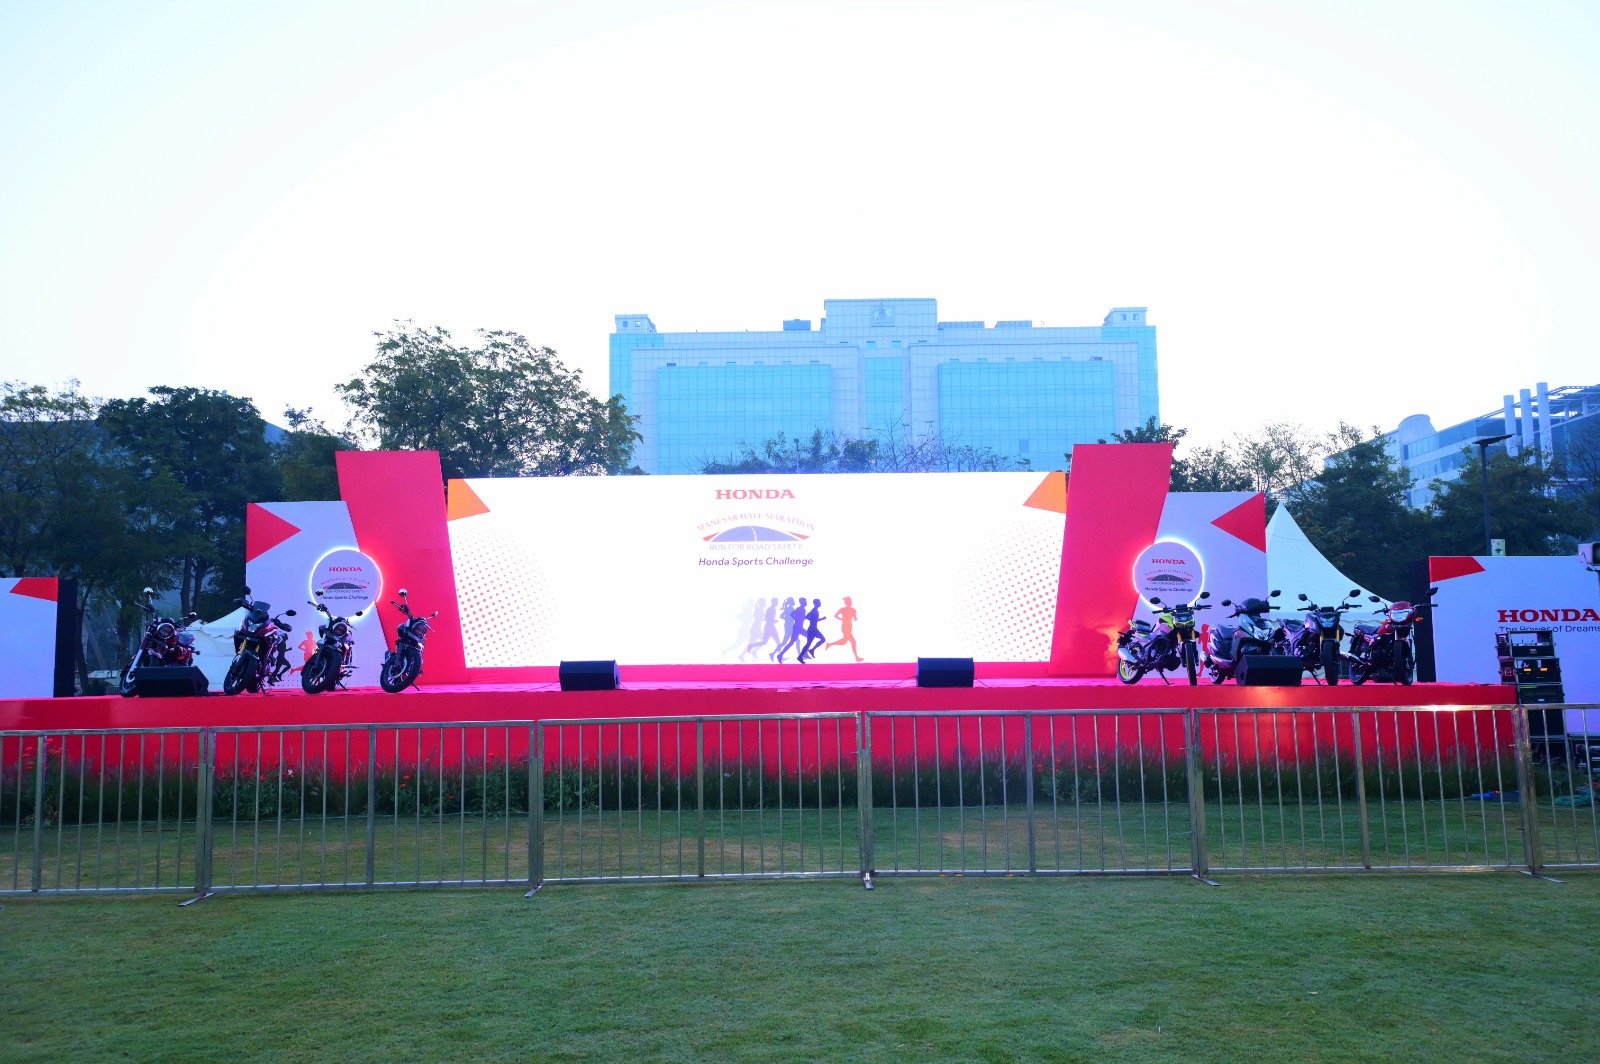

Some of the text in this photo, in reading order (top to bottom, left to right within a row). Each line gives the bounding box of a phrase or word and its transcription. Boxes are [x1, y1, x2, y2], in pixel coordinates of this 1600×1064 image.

[714, 489, 796, 500] HONDA
[765, 512, 816, 532] MARATHON
[772, 543, 802, 551] SAFETY
[698, 556, 814, 567] Honda Sports Challenge
[1497, 608, 1600, 622] HONDA
